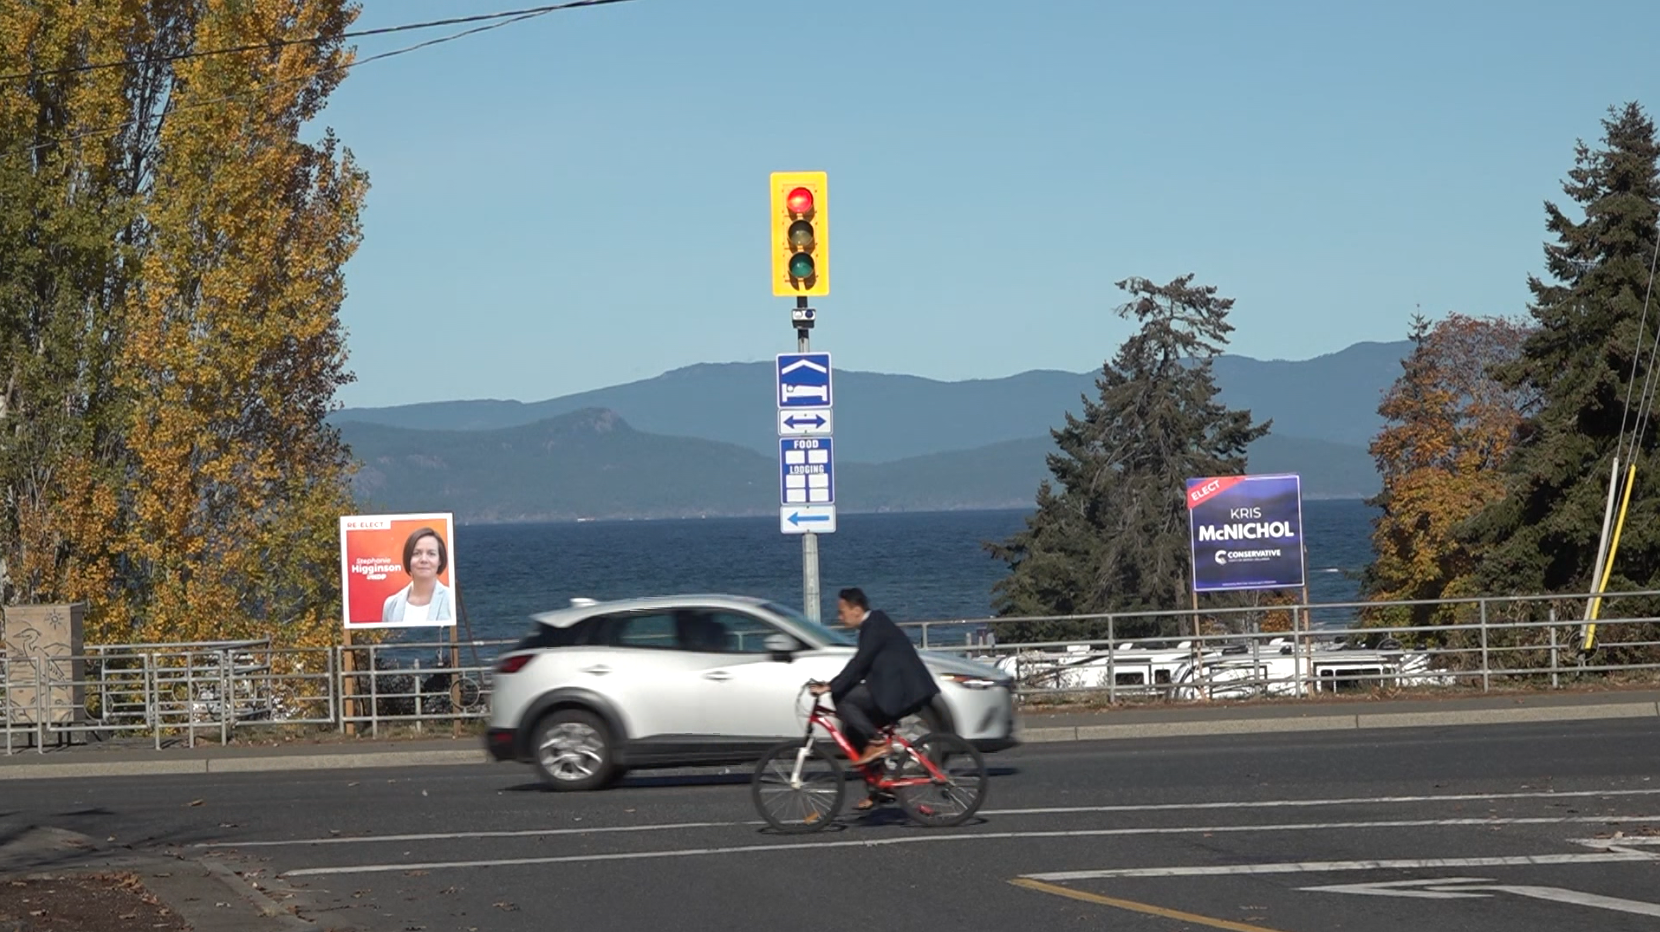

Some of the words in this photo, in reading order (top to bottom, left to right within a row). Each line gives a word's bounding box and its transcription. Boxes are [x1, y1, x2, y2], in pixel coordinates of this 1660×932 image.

[793, 439, 819, 449] FOOD
[789, 464, 825, 474] LODGING
[1190, 479, 1221, 501] ELECT
[1230, 507, 1262, 519] KRIS
[1198, 521, 1295, 542] McNICHOL
[1227, 549, 1281, 559] CONSERVATIVE
[355, 557, 392, 565] Stephanie
[351, 563, 402, 575] Higginson
